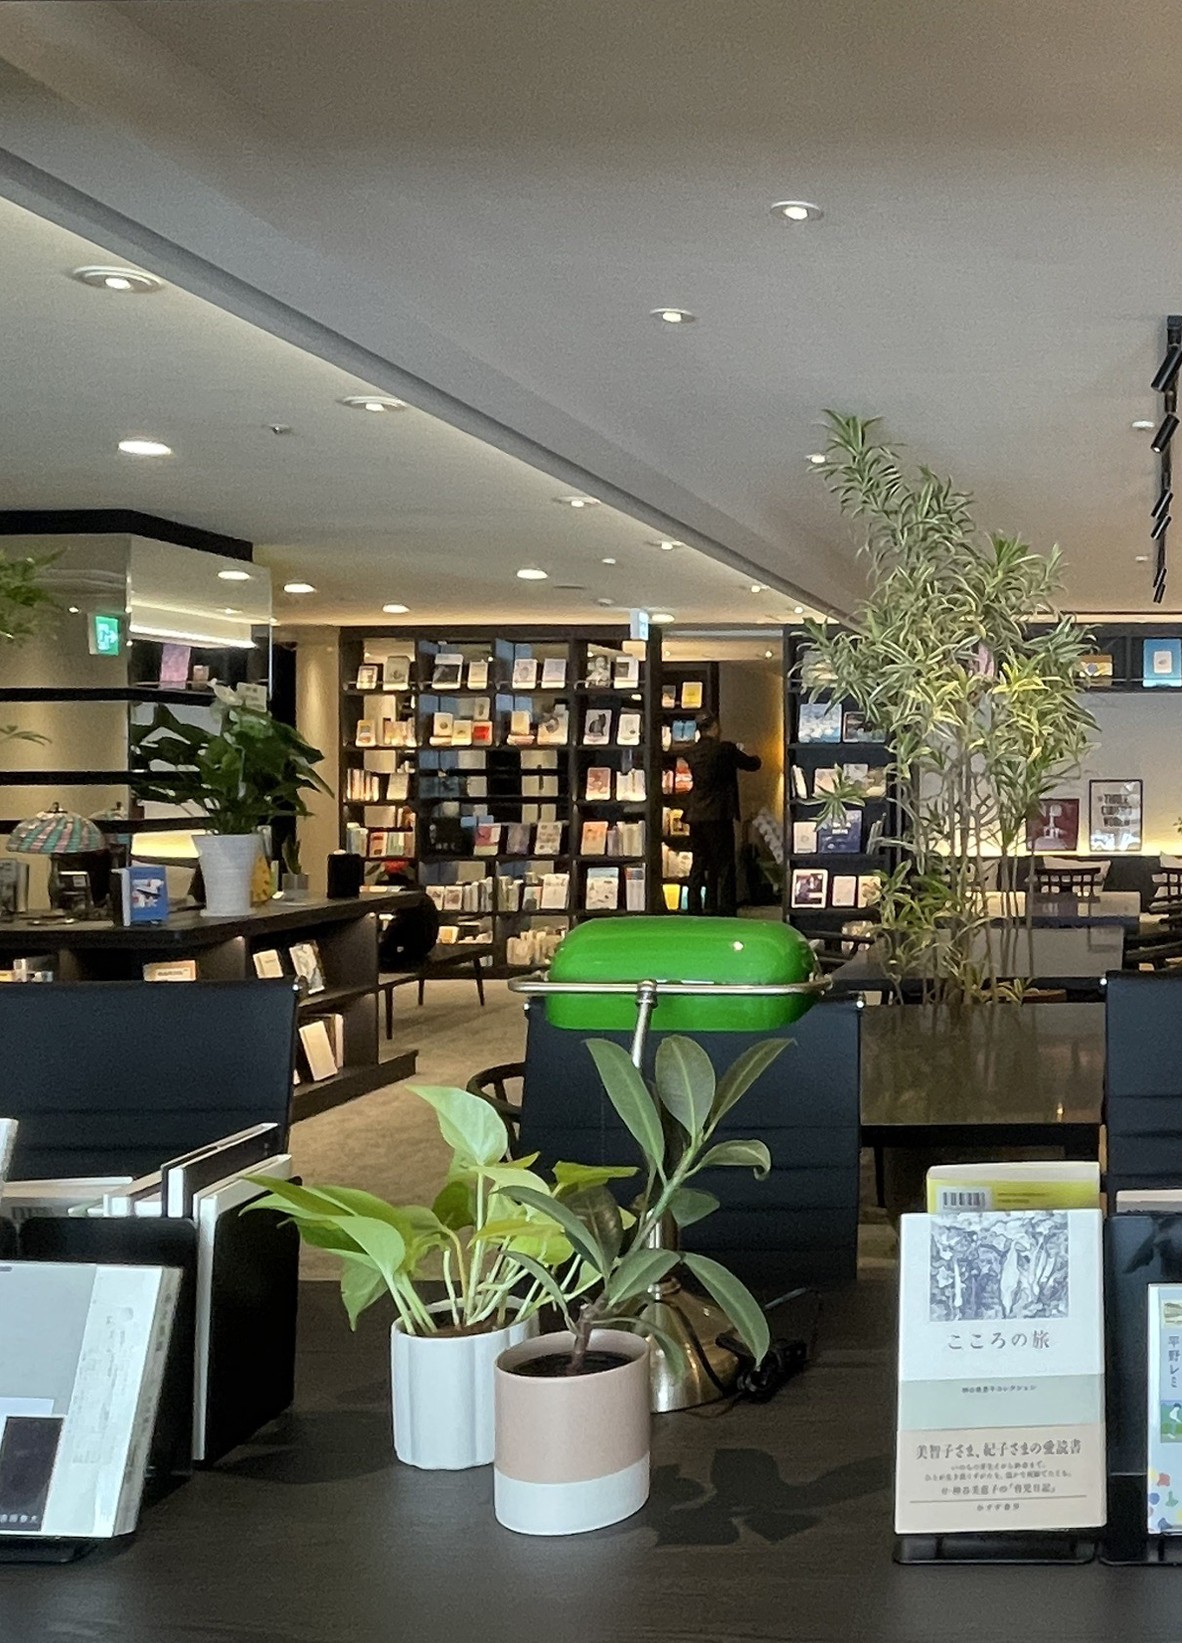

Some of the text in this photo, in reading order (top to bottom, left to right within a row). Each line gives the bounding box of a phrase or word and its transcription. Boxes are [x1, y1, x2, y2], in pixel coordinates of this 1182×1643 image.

[946, 1330, 1051, 1351] こころの旅
